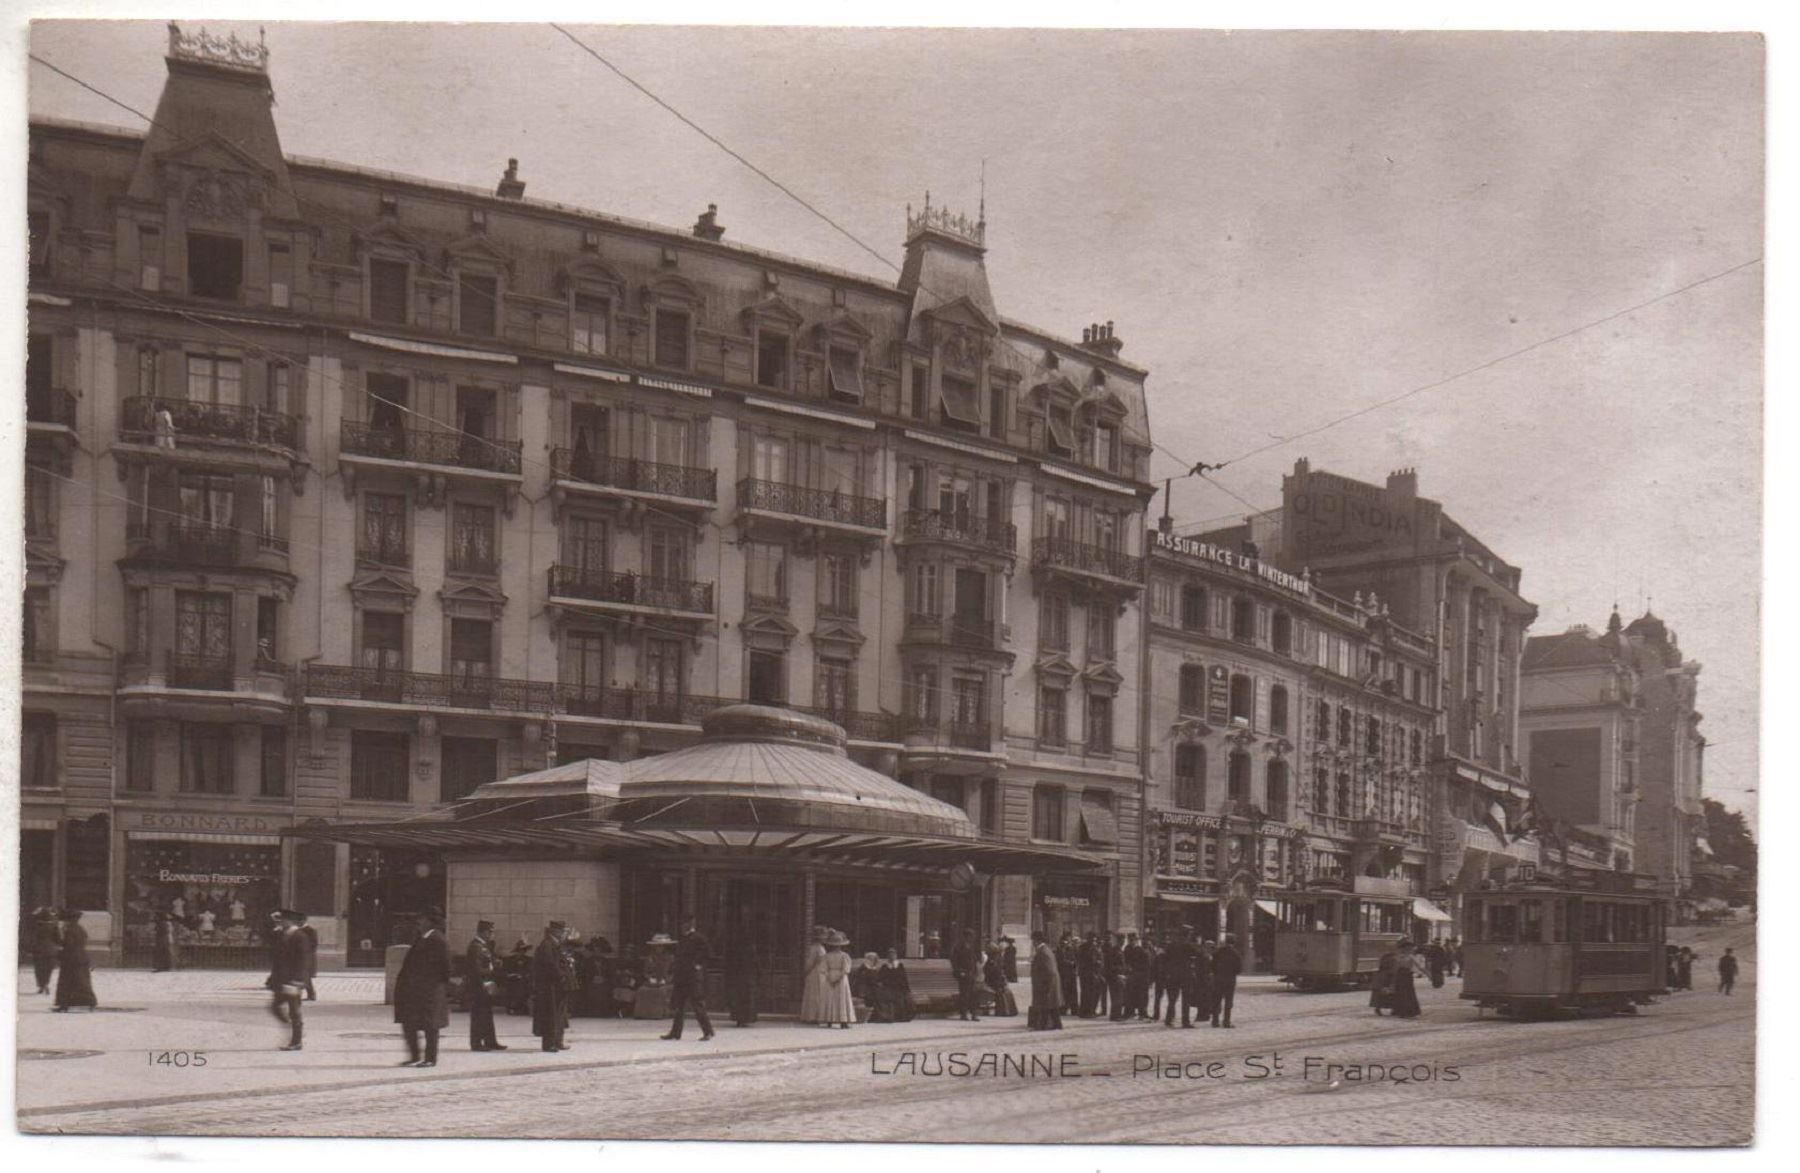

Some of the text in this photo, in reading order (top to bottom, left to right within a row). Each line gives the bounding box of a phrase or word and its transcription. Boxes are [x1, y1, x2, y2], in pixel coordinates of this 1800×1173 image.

[1157, 532, 1232, 566] ASSURANCE
[1239, 555, 1251, 572] LA
[142, 815, 267, 831] BONNARD
[1520, 866, 1534, 881] 10
